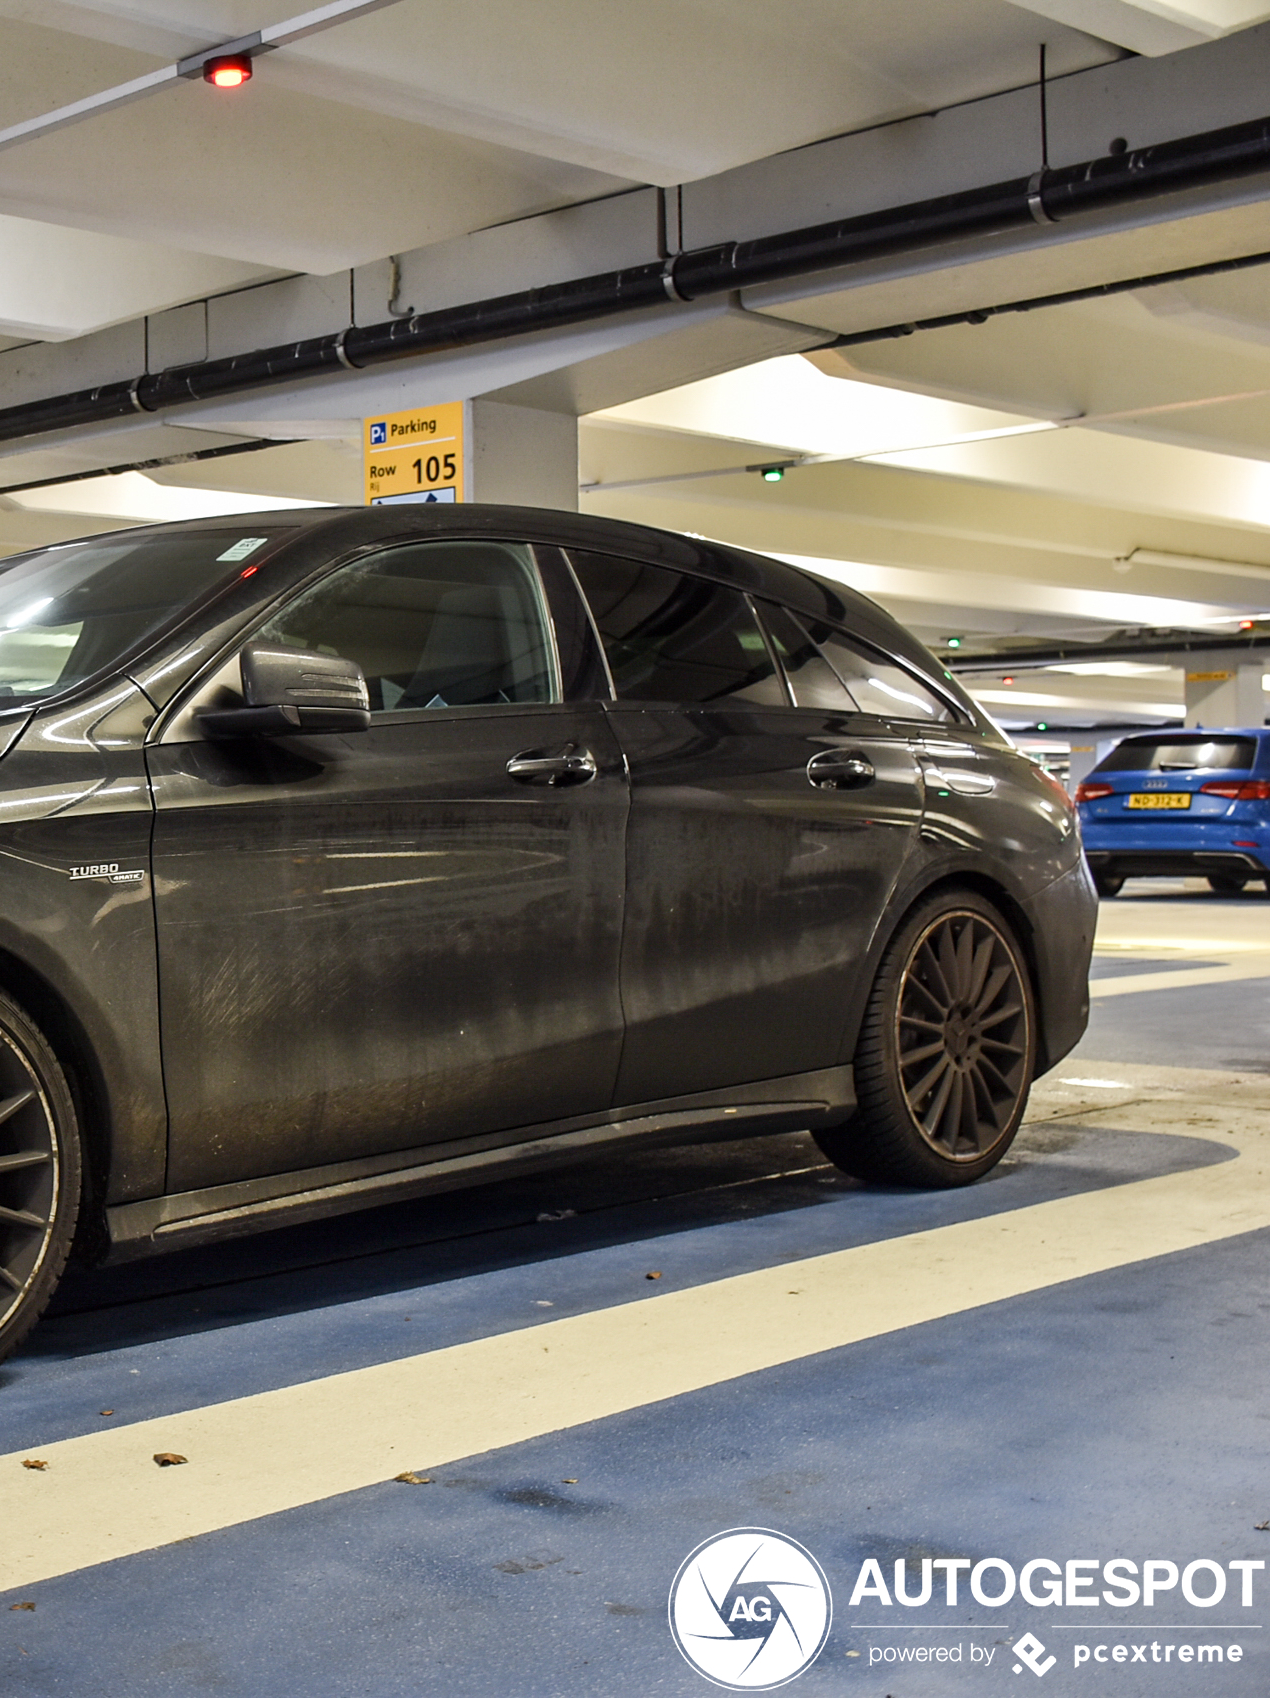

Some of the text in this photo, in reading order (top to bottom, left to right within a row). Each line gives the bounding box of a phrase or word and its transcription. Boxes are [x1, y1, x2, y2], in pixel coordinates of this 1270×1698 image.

[391, 419, 436, 437] Parking
[370, 453, 456, 484] Row 105
[370, 482, 379, 492] Rij
[1133, 796, 1184, 807] ND-312-K
[69, 863, 119, 876] TURBO
